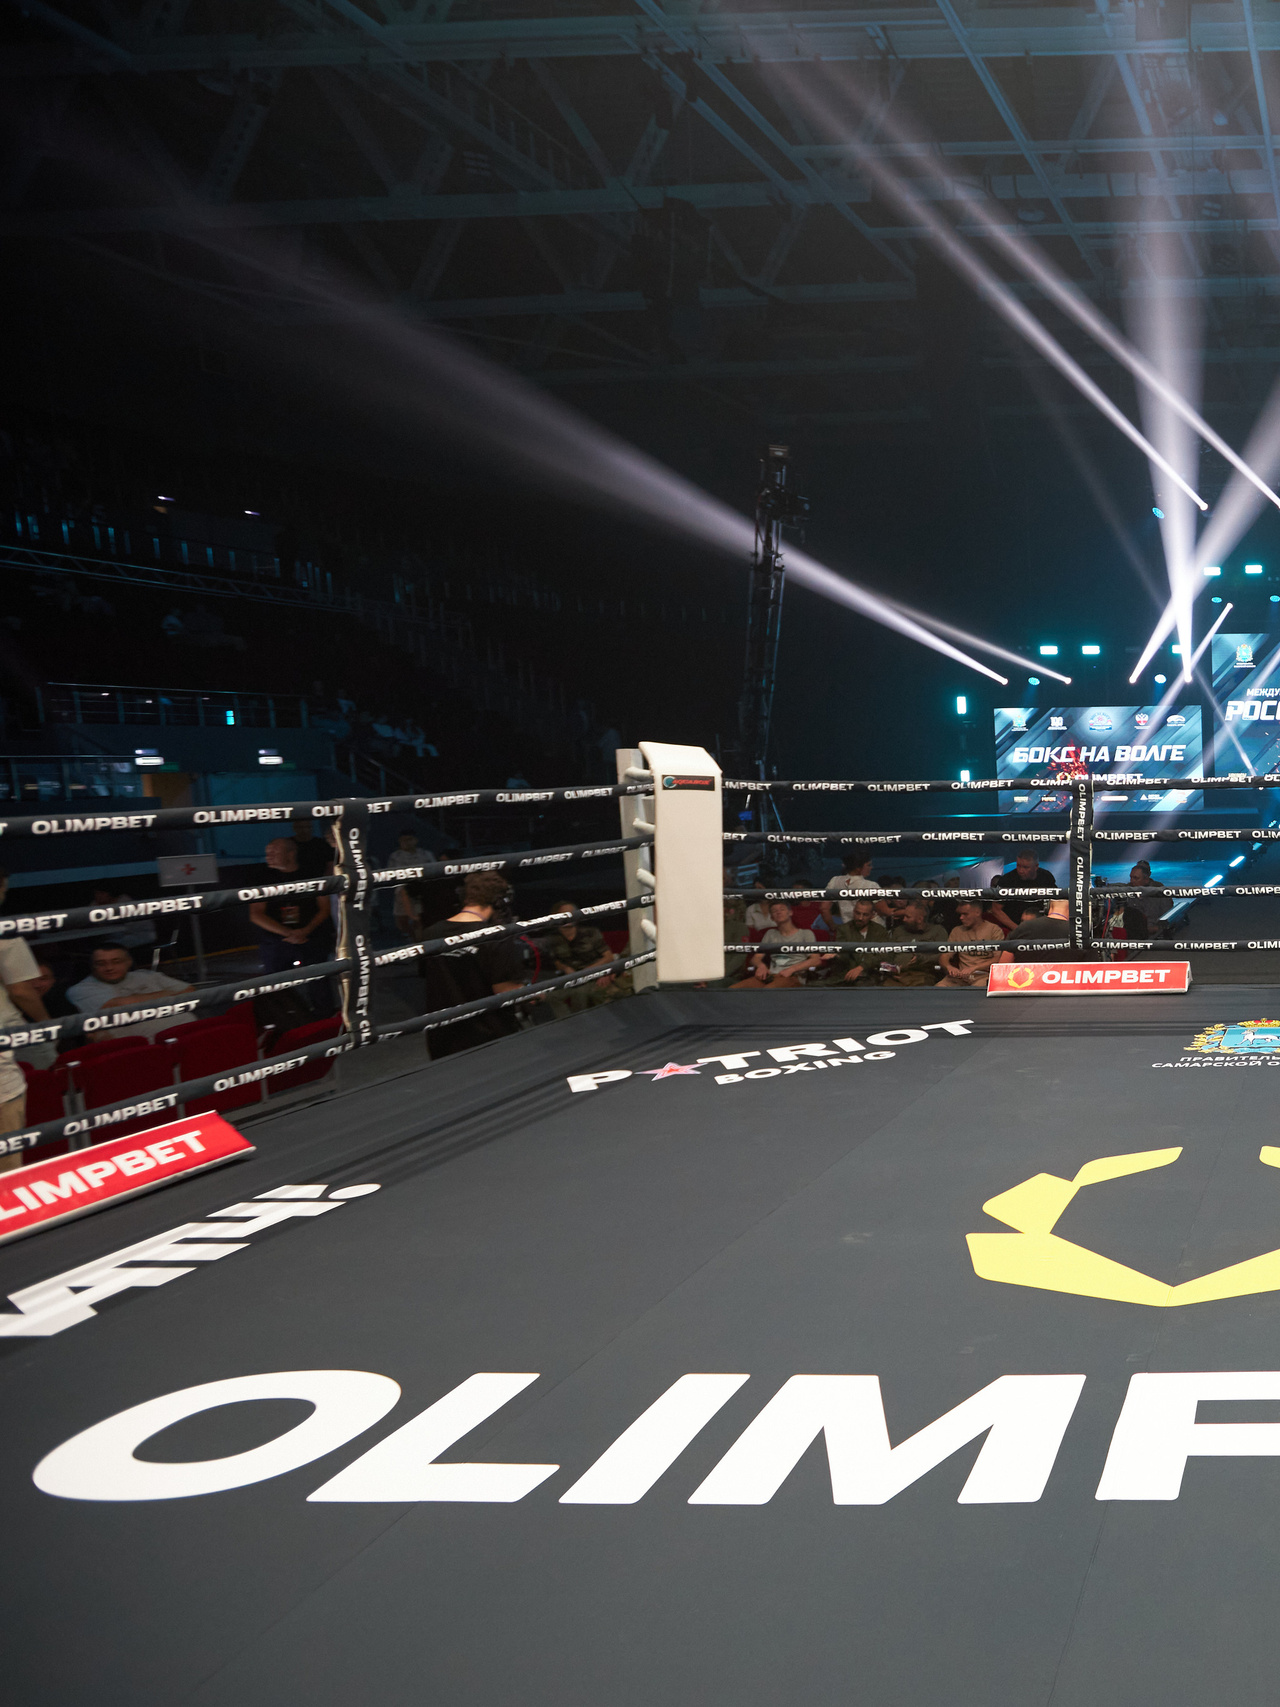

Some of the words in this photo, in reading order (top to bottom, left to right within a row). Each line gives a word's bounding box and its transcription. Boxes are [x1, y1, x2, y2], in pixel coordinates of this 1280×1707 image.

[1013, 747, 1075, 763] БОКС
[1080, 746, 1110, 762] НА
[1114, 745, 1186, 762] ВОЛГЕ
[792, 783, 854, 791] OLIMPBET
[868, 783, 930, 792] OLIMPBET
[951, 780, 1014, 789] OLIMPBET
[1106, 777, 1169, 786] OLIMPBET
[32, 814, 157, 835] OLIMPBET
[193, 807, 293, 824] OLIMPBET
[414, 794, 480, 808] OLIMPBET
[496, 792, 554, 803] OLIMPBET
[564, 788, 613, 799] OLIMPBET
[1078, 784, 1086, 841] OLIMPBET
[767, 834, 827, 843] OLIMPBET
[841, 835, 901, 844] OLIMPBET
[922, 832, 985, 841] OLIMPBET
[1002, 833, 1064, 842] OLIMPBET
[1095, 832, 1157, 841] OLIMPBET
[1178, 831, 1241, 839] OLIMPBET
[89, 896, 202, 922] OLIMPBET
[238, 880, 327, 901] OLIMPBET
[444, 861, 506, 875] OLIMPBET
[520, 853, 573, 866] OLIMPBET
[349, 828, 367, 911] OLIMPBET
[765, 891, 826, 899] OLIMPBET
[839, 889, 900, 897] OLIMPBET
[921, 889, 983, 898] OLIMPBET
[999, 888, 1061, 896] OLIMPBET
[1163, 887, 1225, 896] OLIMPBET
[83, 1000, 200, 1031] OLIMPBET
[444, 924, 506, 945] OLIMPBET
[581, 899, 627, 914] OLIMPBET
[780, 945, 842, 953] OLIMPBET
[855, 945, 917, 953] OLIMPBET
[938, 944, 1000, 952] OLIMPBET
[355, 935, 369, 1014] OLIMPBET
[1042, 968, 1170, 985] OLIMPBET
[714, 1051, 896, 1085] BOXING
[63, 1093, 178, 1136] OLIMPBET
[213, 1055, 308, 1092] OLIMPBET
